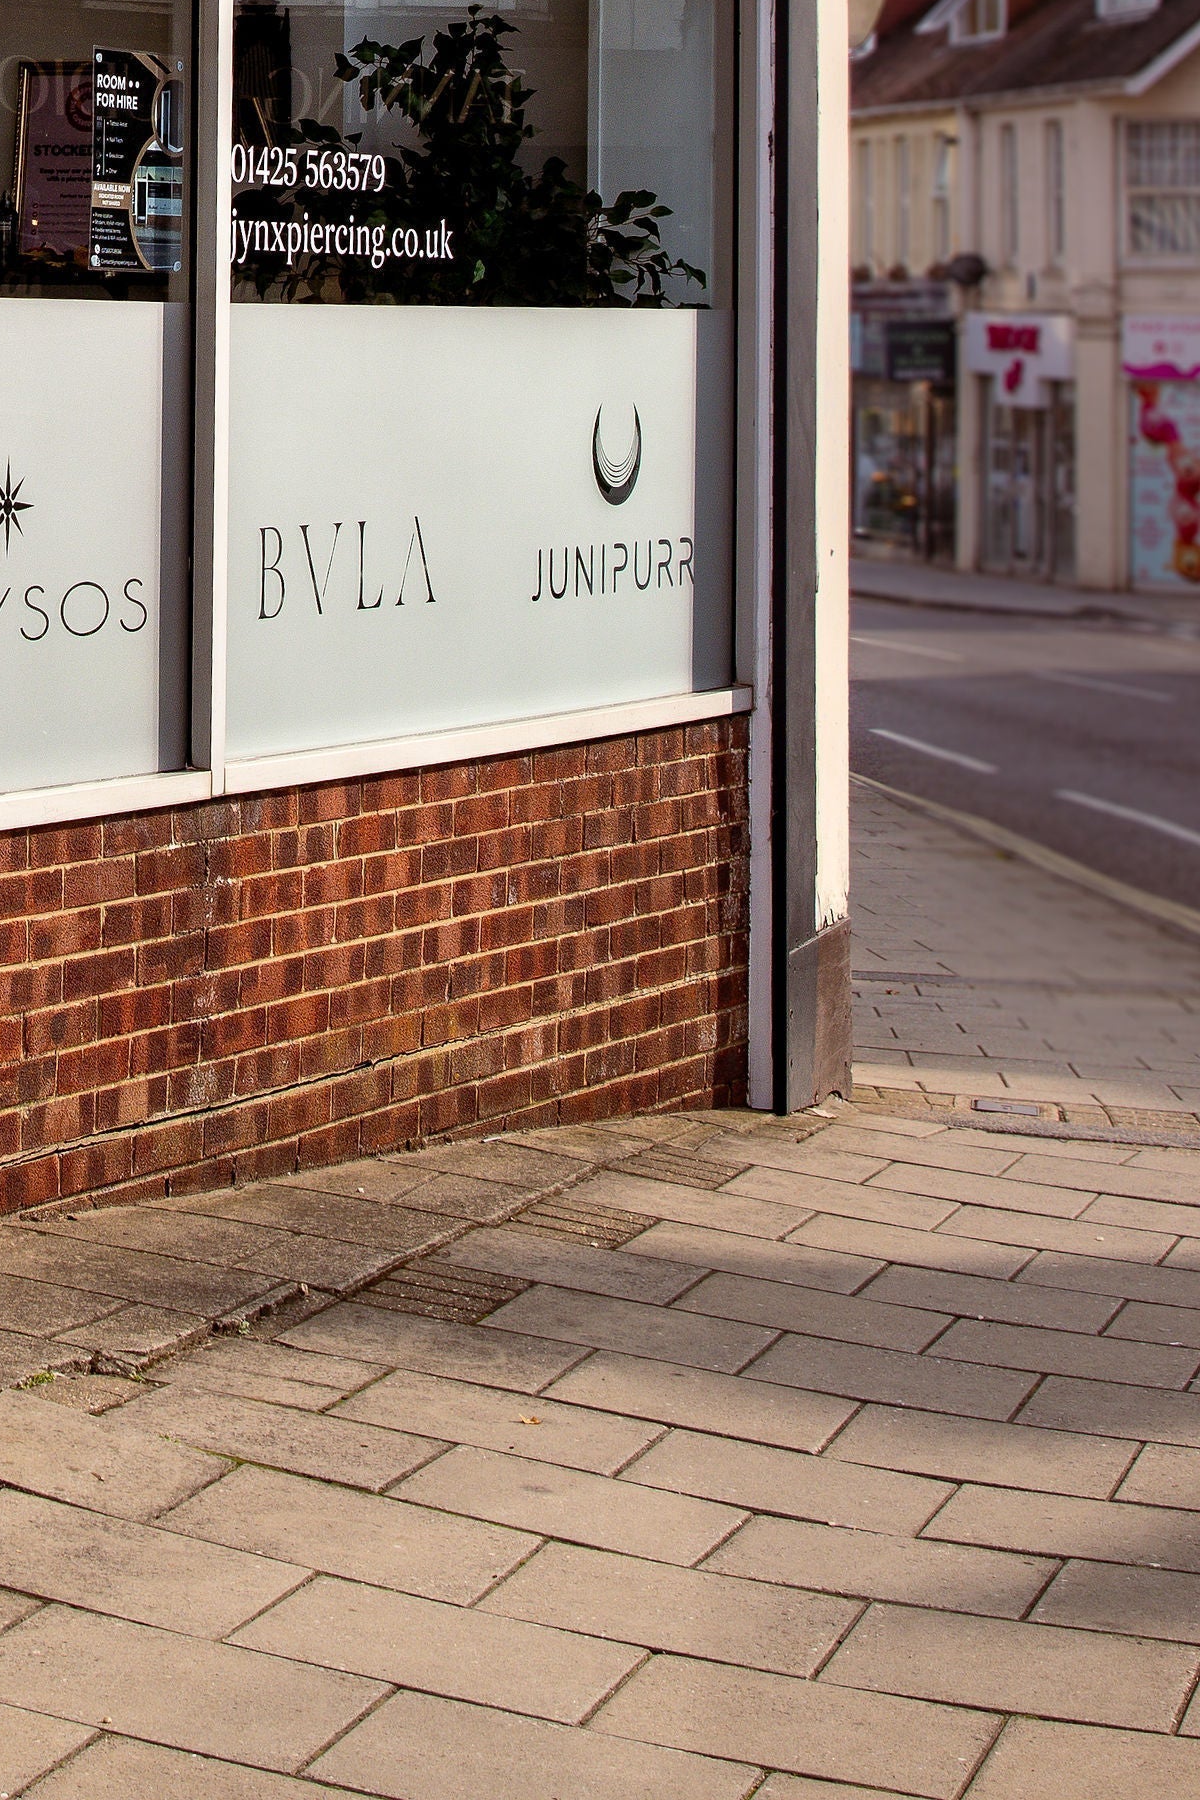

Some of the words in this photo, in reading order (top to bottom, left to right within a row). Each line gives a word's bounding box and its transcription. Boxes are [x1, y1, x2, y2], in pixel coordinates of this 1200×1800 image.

[96, 73, 128, 93] ROOM
[96, 92, 116, 111] FOR
[116, 95, 139, 112] HIRE
[231, 143, 298, 187] 01425
[305, 149, 387, 193] 563579
[230, 207, 455, 269] jynxpiercing.co.uk
[531, 535, 695, 603] JUNIPURR
